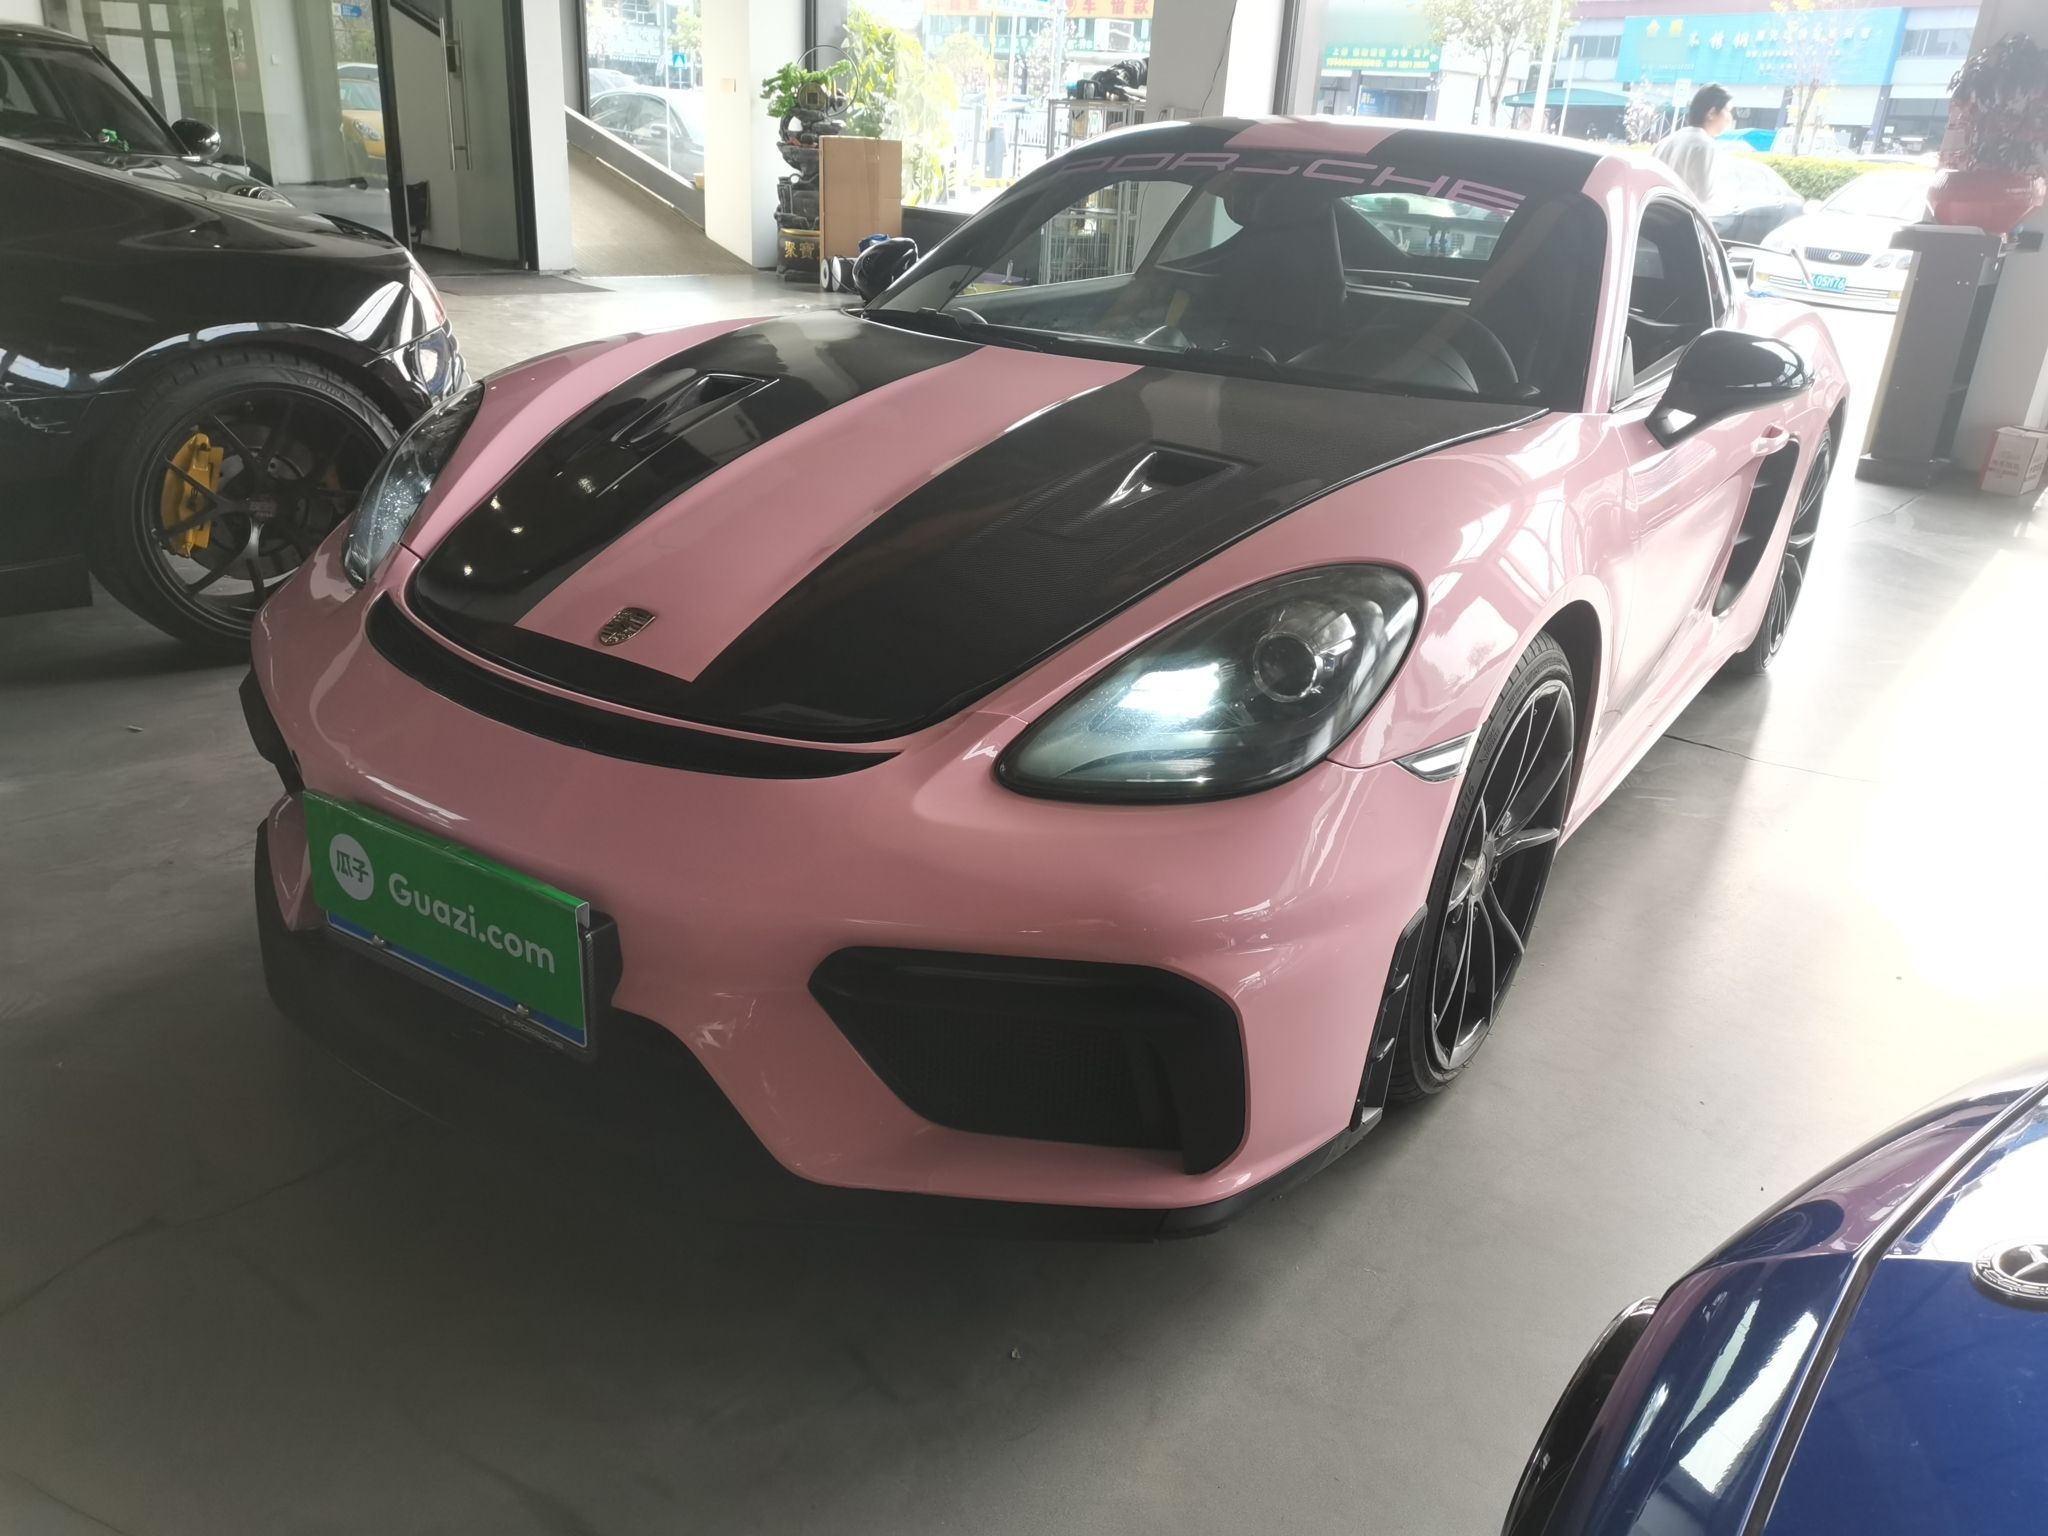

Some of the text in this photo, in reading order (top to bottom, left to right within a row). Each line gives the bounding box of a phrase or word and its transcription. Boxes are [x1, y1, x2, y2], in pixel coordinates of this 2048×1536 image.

[784, 240, 819, 260] 聚寶
[336, 850, 368, 882] 瓜子
[389, 873, 555, 973] Guazi.com
